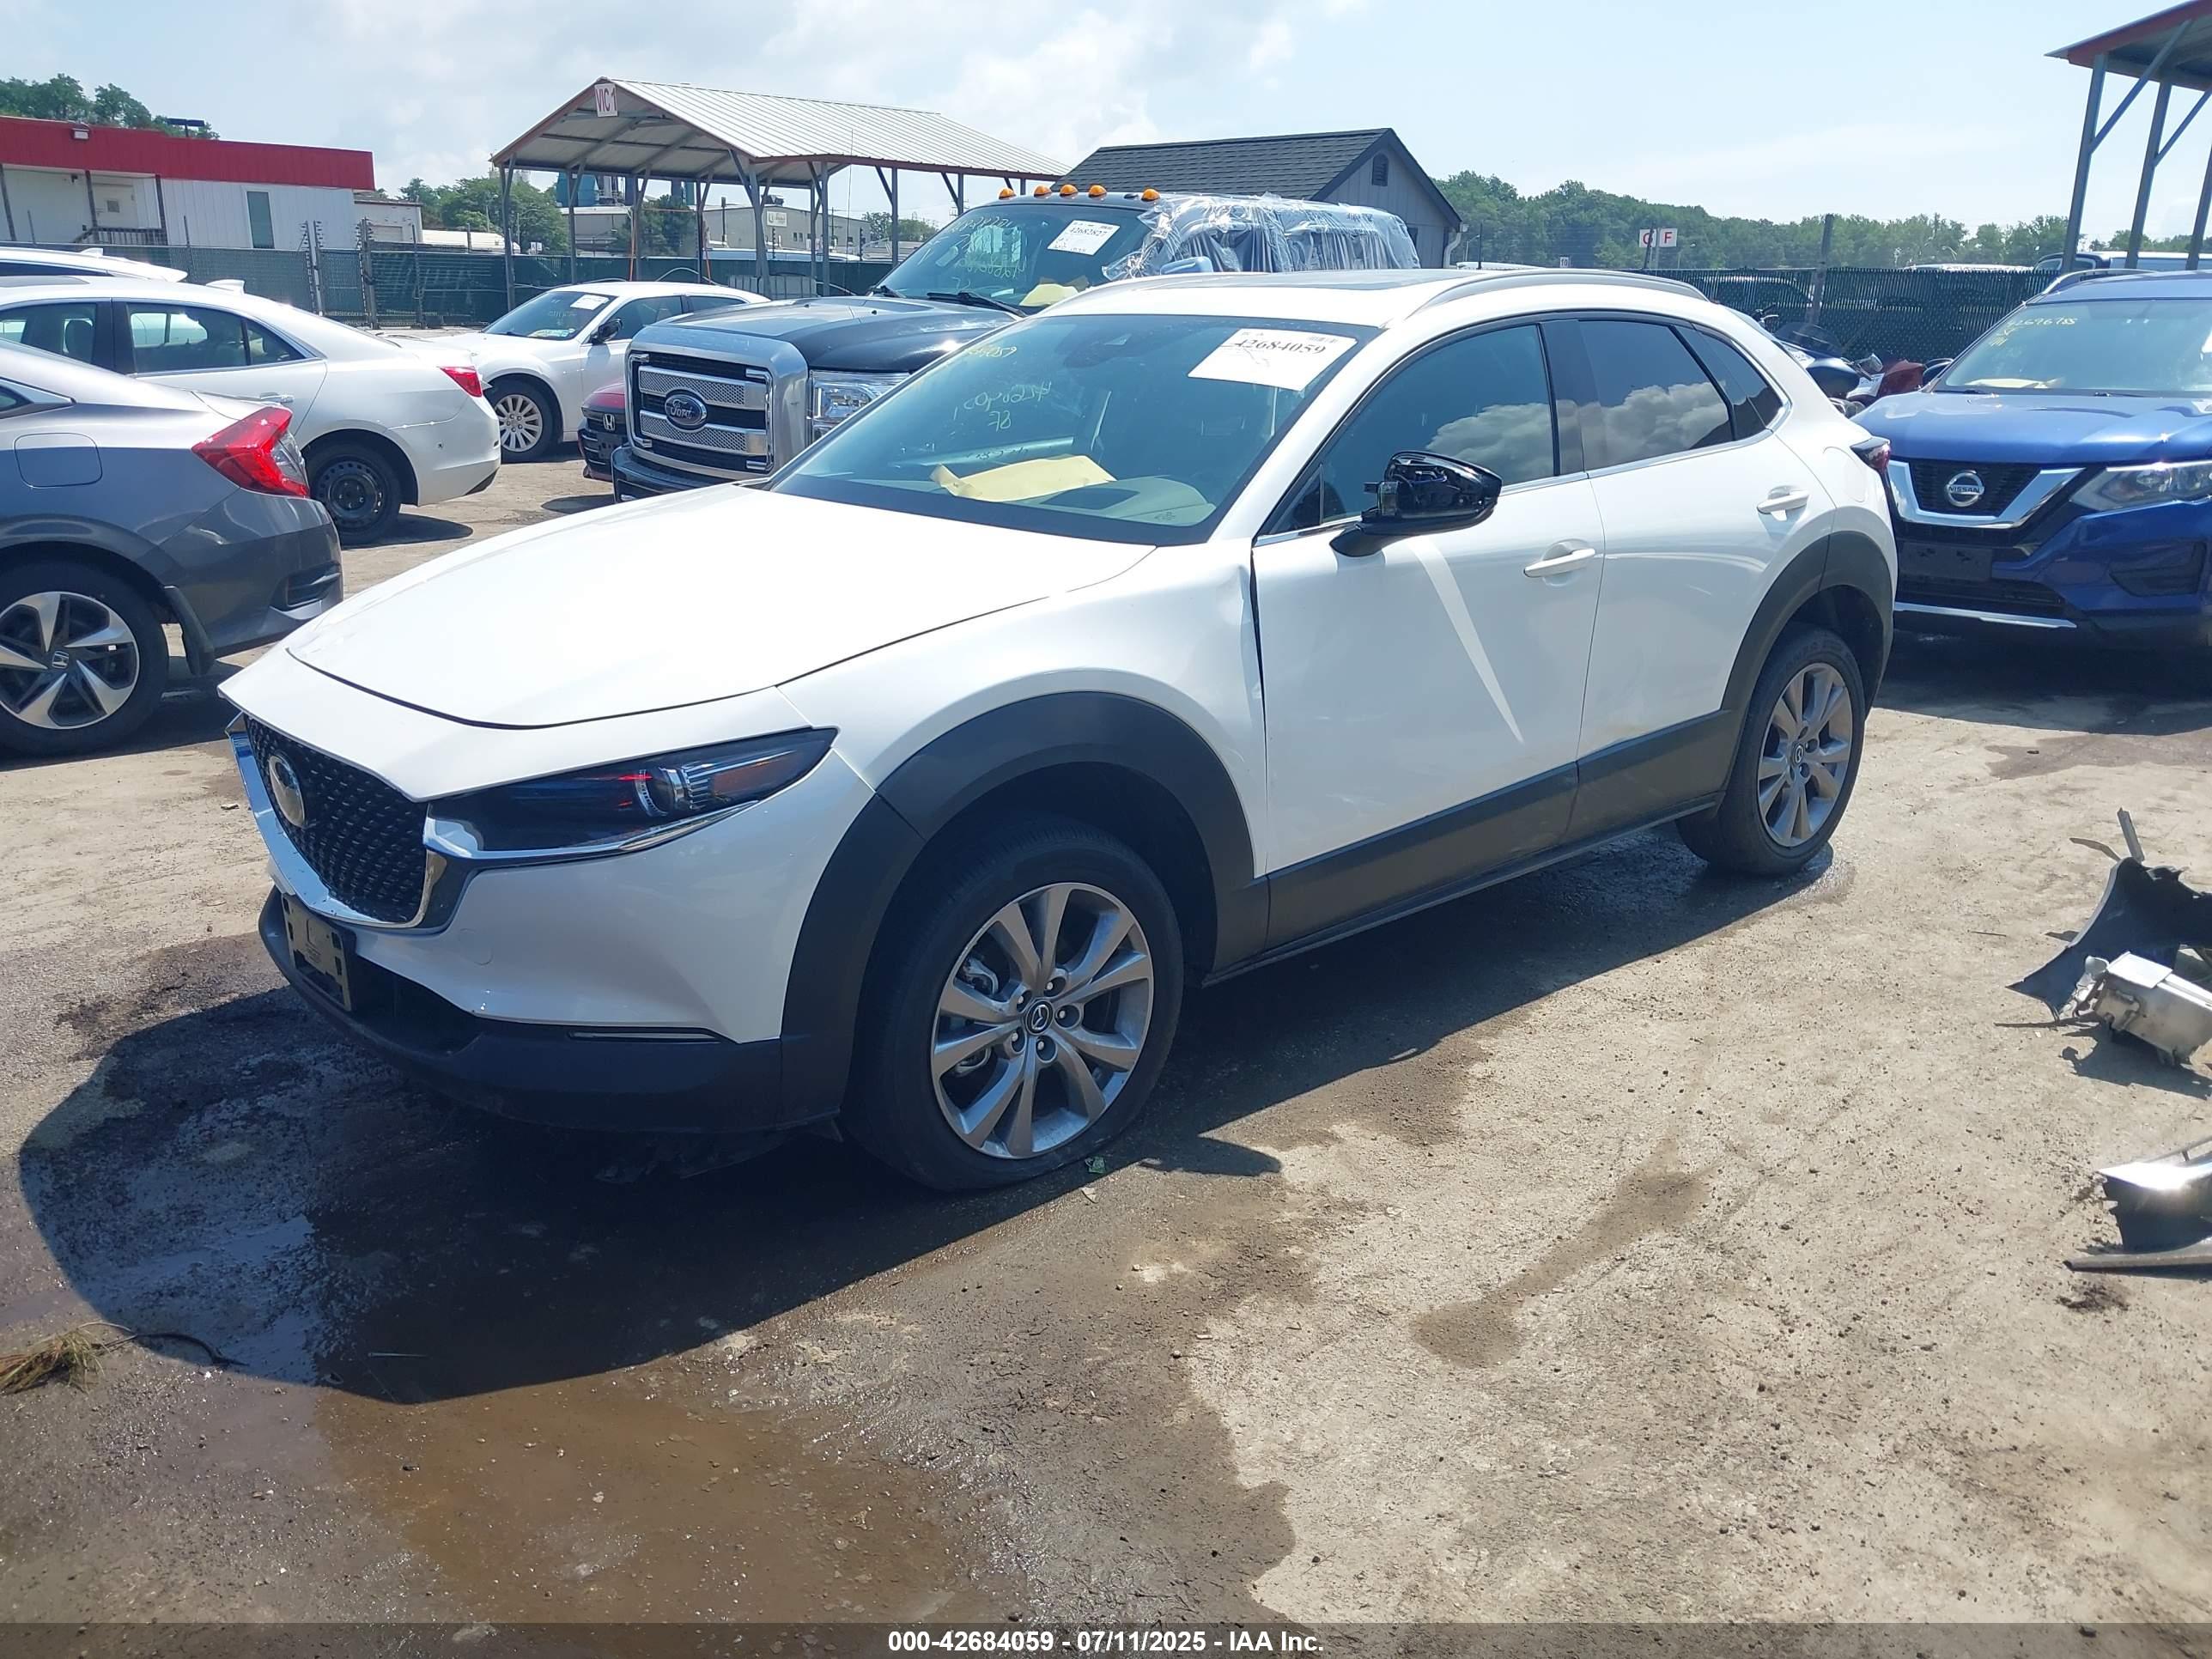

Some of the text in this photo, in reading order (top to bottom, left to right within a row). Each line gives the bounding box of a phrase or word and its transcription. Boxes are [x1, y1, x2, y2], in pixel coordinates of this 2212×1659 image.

[595, 87, 617, 112] VIC 1
[1664, 231, 1673, 244] F
[1233, 338, 1327, 355] 42684059
[670, 398, 695, 420] Ford
